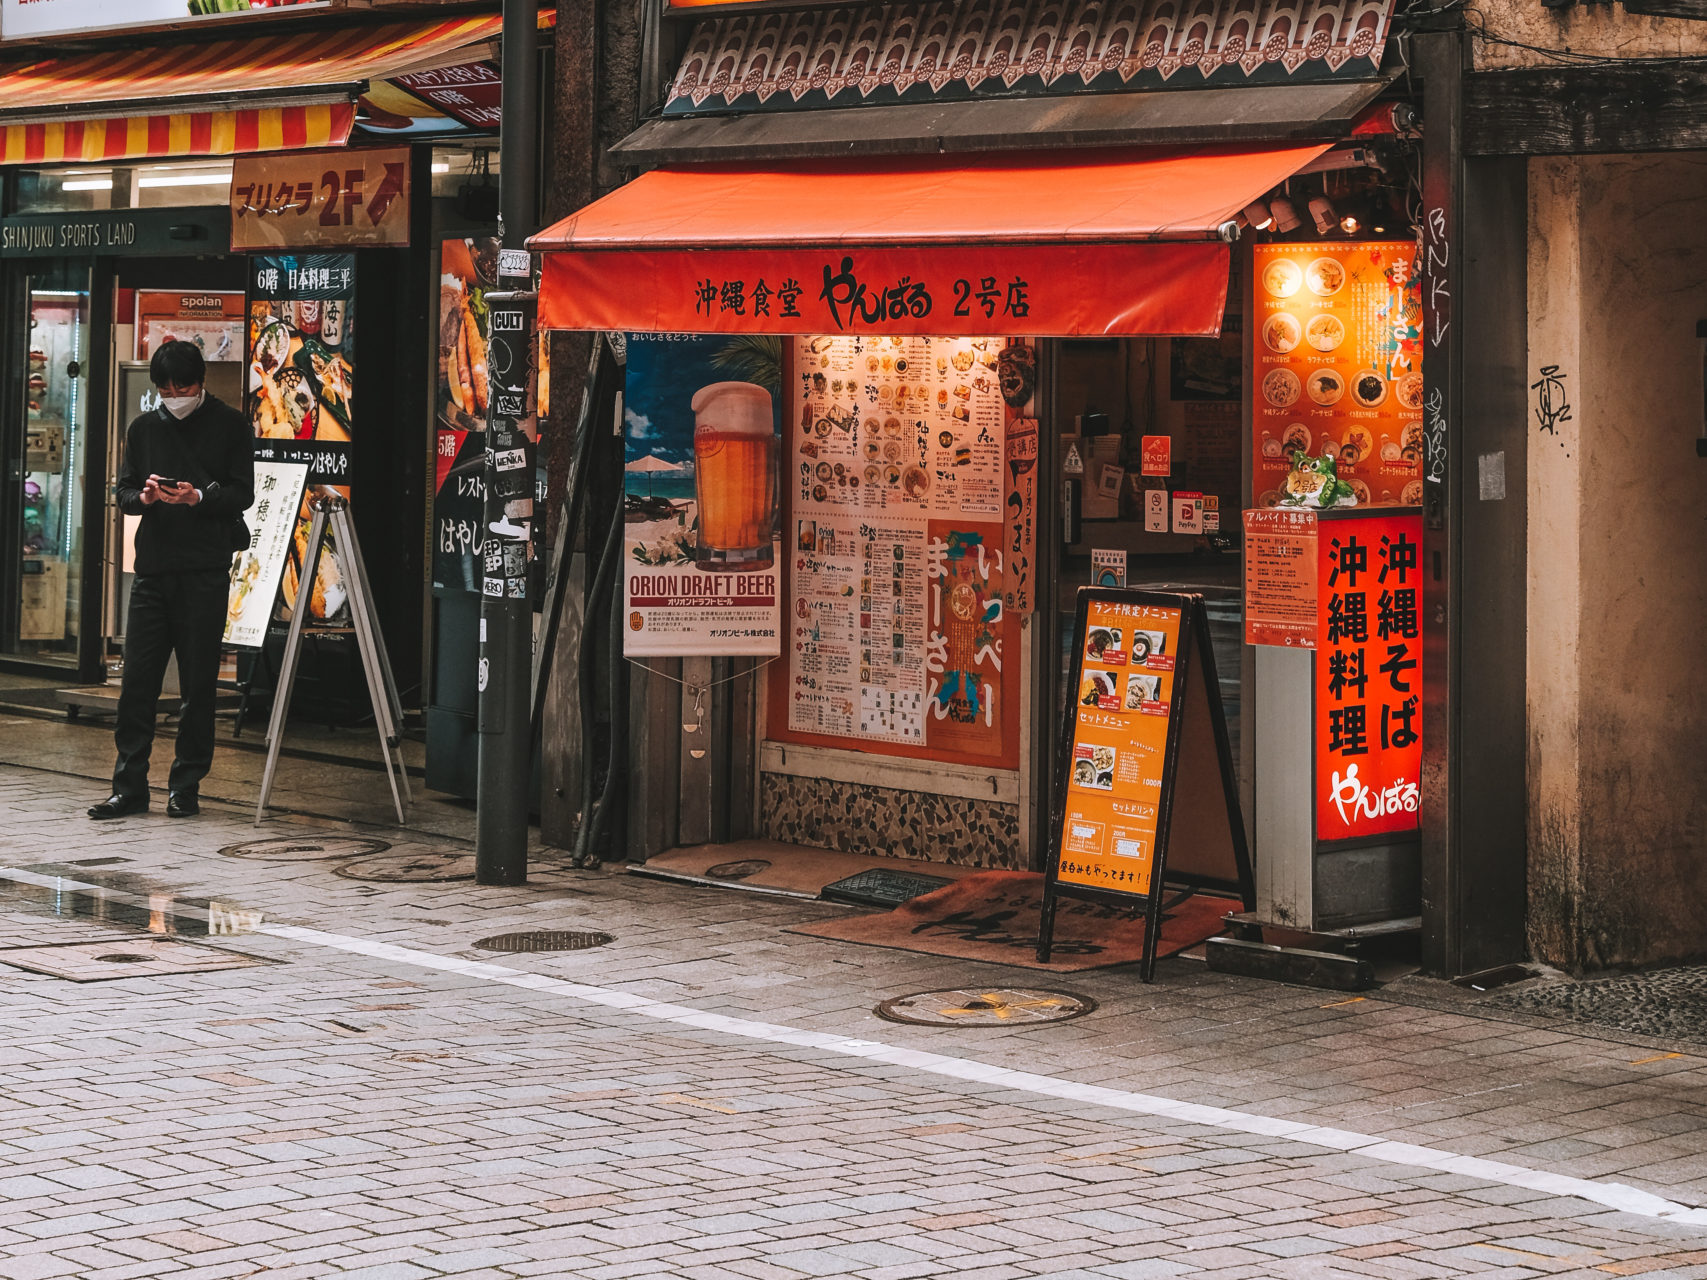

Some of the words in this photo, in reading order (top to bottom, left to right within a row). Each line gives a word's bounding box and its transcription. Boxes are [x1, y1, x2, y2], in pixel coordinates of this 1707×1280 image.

[236, 181, 314, 218] プリクラ
[319, 169, 365, 227] 2F
[3, 225, 54, 251] SHINJUKU
[60, 223, 100, 247] SPORTS
[107, 222, 135, 246] LAND
[257, 269, 279, 291] 6階
[288, 268, 351, 290] 日本料理三平
[181, 296, 222, 308] spolan
[695, 277, 804, 318] 沖縄食堂
[819, 256, 932, 330] やんばる
[953, 277, 1030, 318] 2号店
[495, 312, 522, 330] CULT
[438, 434, 456, 457] 5階
[1178, 521, 1197, 529] PayPay
[1246, 512, 1314, 525] アルバイト募集中
[630, 575, 677, 596] ORION
[682, 575, 733, 596] DRAFT
[737, 575, 775, 596] BEER
[1094, 602, 1179, 620] ランチ限定メニュー
[710, 630, 776, 638] オリオンビール株式会社
[1377, 533, 1419, 750] 沖縄そば
[1327, 535, 1369, 756] 沖縄料理
[1079, 712, 1131, 727] セットメニュー
[1329, 763, 1421, 826] やんばる
[1112, 802, 1154, 816] セットドリンク
